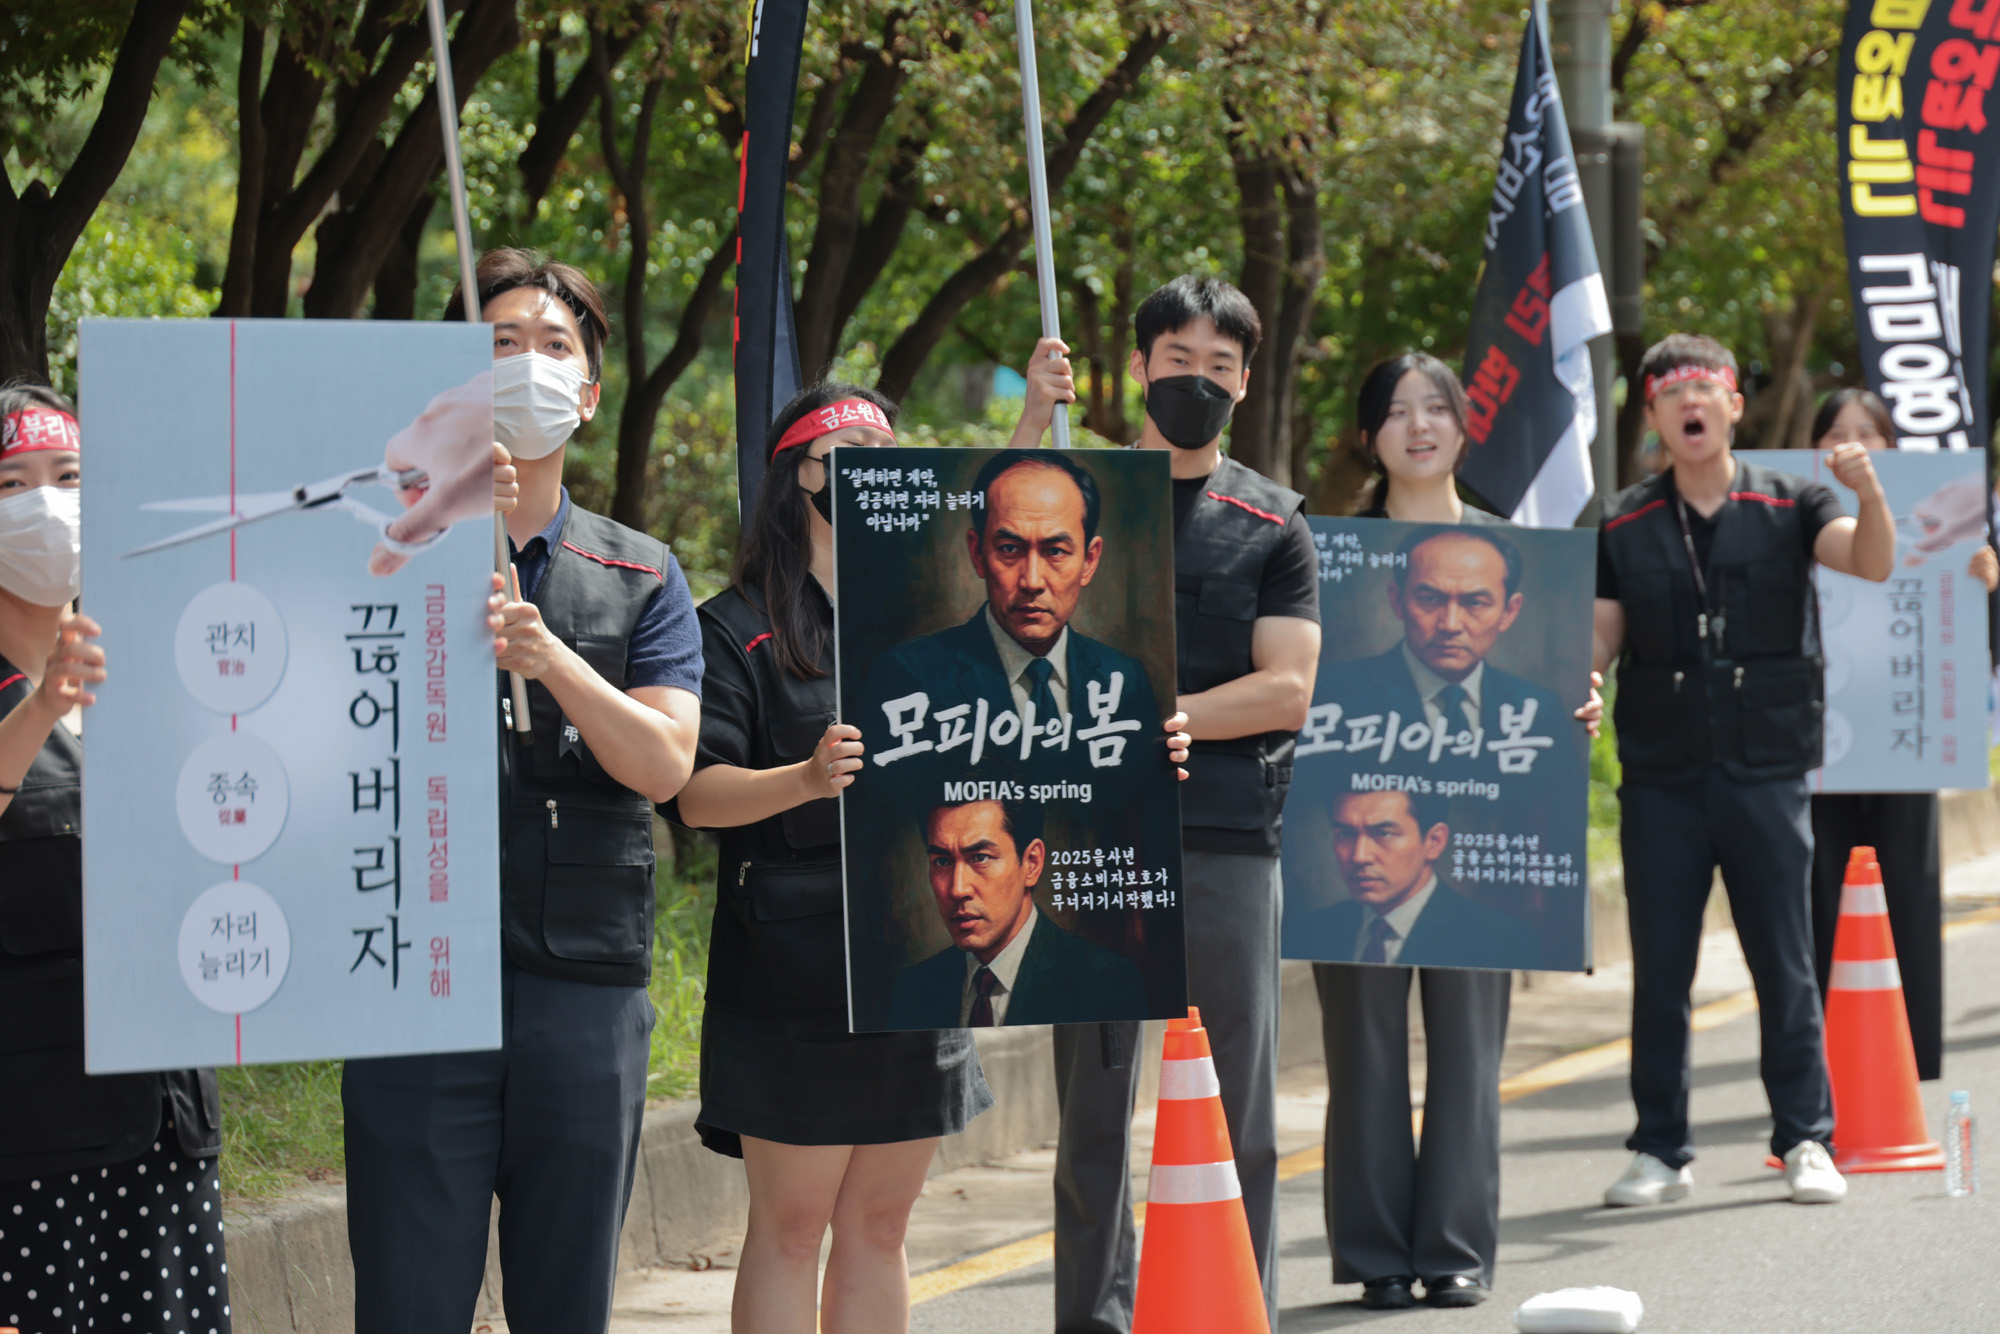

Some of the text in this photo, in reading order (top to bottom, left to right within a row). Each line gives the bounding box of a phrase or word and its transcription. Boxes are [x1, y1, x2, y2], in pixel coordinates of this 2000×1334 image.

[1858, 252, 1970, 452] 금융
[855, 490, 985, 511] 성공하면 자리 늘리기
[205, 620, 256, 656] 관치
[1887, 577, 1934, 760] 끊어버리자
[872, 670, 1142, 769] 모피아의 봄
[1486, 697, 1554, 774] 봄
[206, 770, 259, 805] 종속
[344, 603, 412, 991] 끊어버리자
[425, 584, 451, 998] 금융감독원 독립성을 위해
[943, 780, 1093, 804] MOFIA's spring
[1350, 772, 1500, 801] MOFIA's spring
[1050, 867, 1169, 890] 금융소비자보호가
[210, 910, 258, 944] 자리
[198, 946, 271, 981] 늘리기
